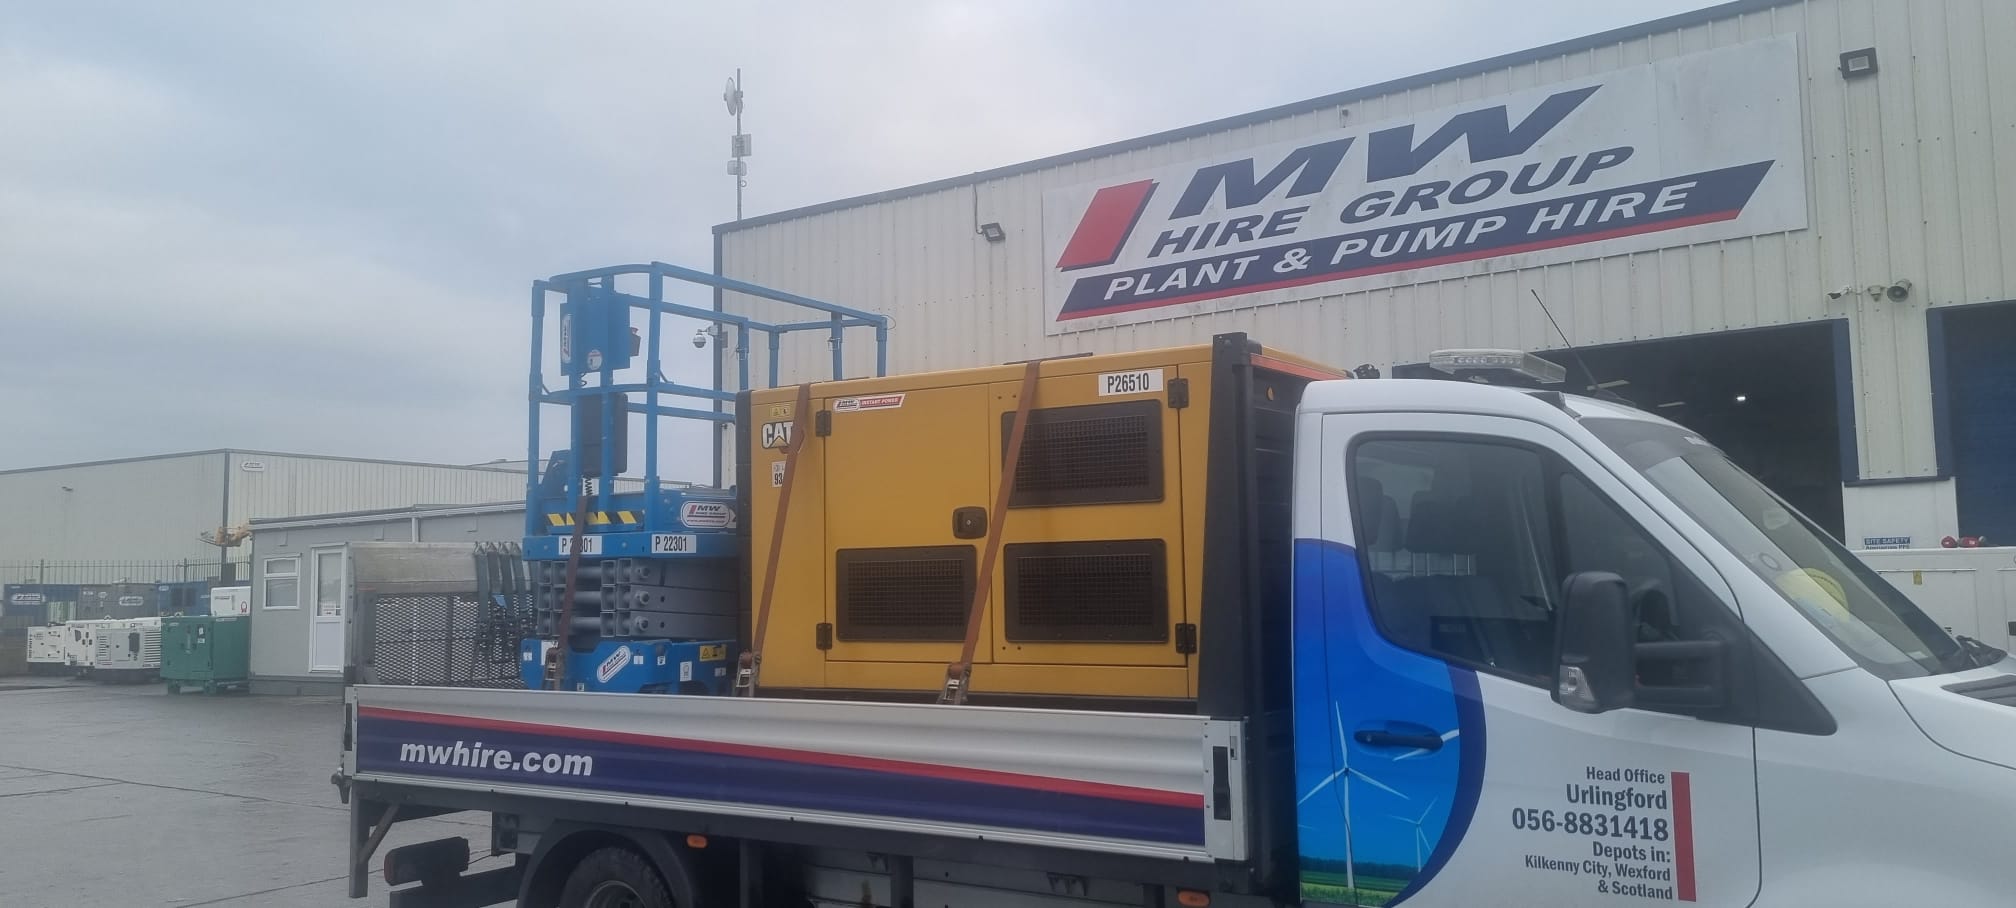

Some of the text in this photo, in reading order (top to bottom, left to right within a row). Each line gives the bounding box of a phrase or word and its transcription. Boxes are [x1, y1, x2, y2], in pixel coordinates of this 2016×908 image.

[1168, 84, 1604, 221] MW
[1147, 146, 1635, 259] HIRE GROUP
[1103, 181, 1698, 301] PLANT & PUMP HIRE
[1107, 372, 1150, 393] P26510
[762, 421, 794, 449] CAT
[655, 536, 687, 552] P 22301
[400, 741, 593, 776] mwhire.com
[1586, 766, 1665, 784] Head Office
[1566, 783, 1667, 811] Urlingford
[1512, 807, 1669, 841] 056-8831418
[1593, 841, 1671, 863] Depots in:
[1525, 854, 1671, 881] Kilkenny City, Wexford
[1598, 880, 1673, 900] & Scotland
